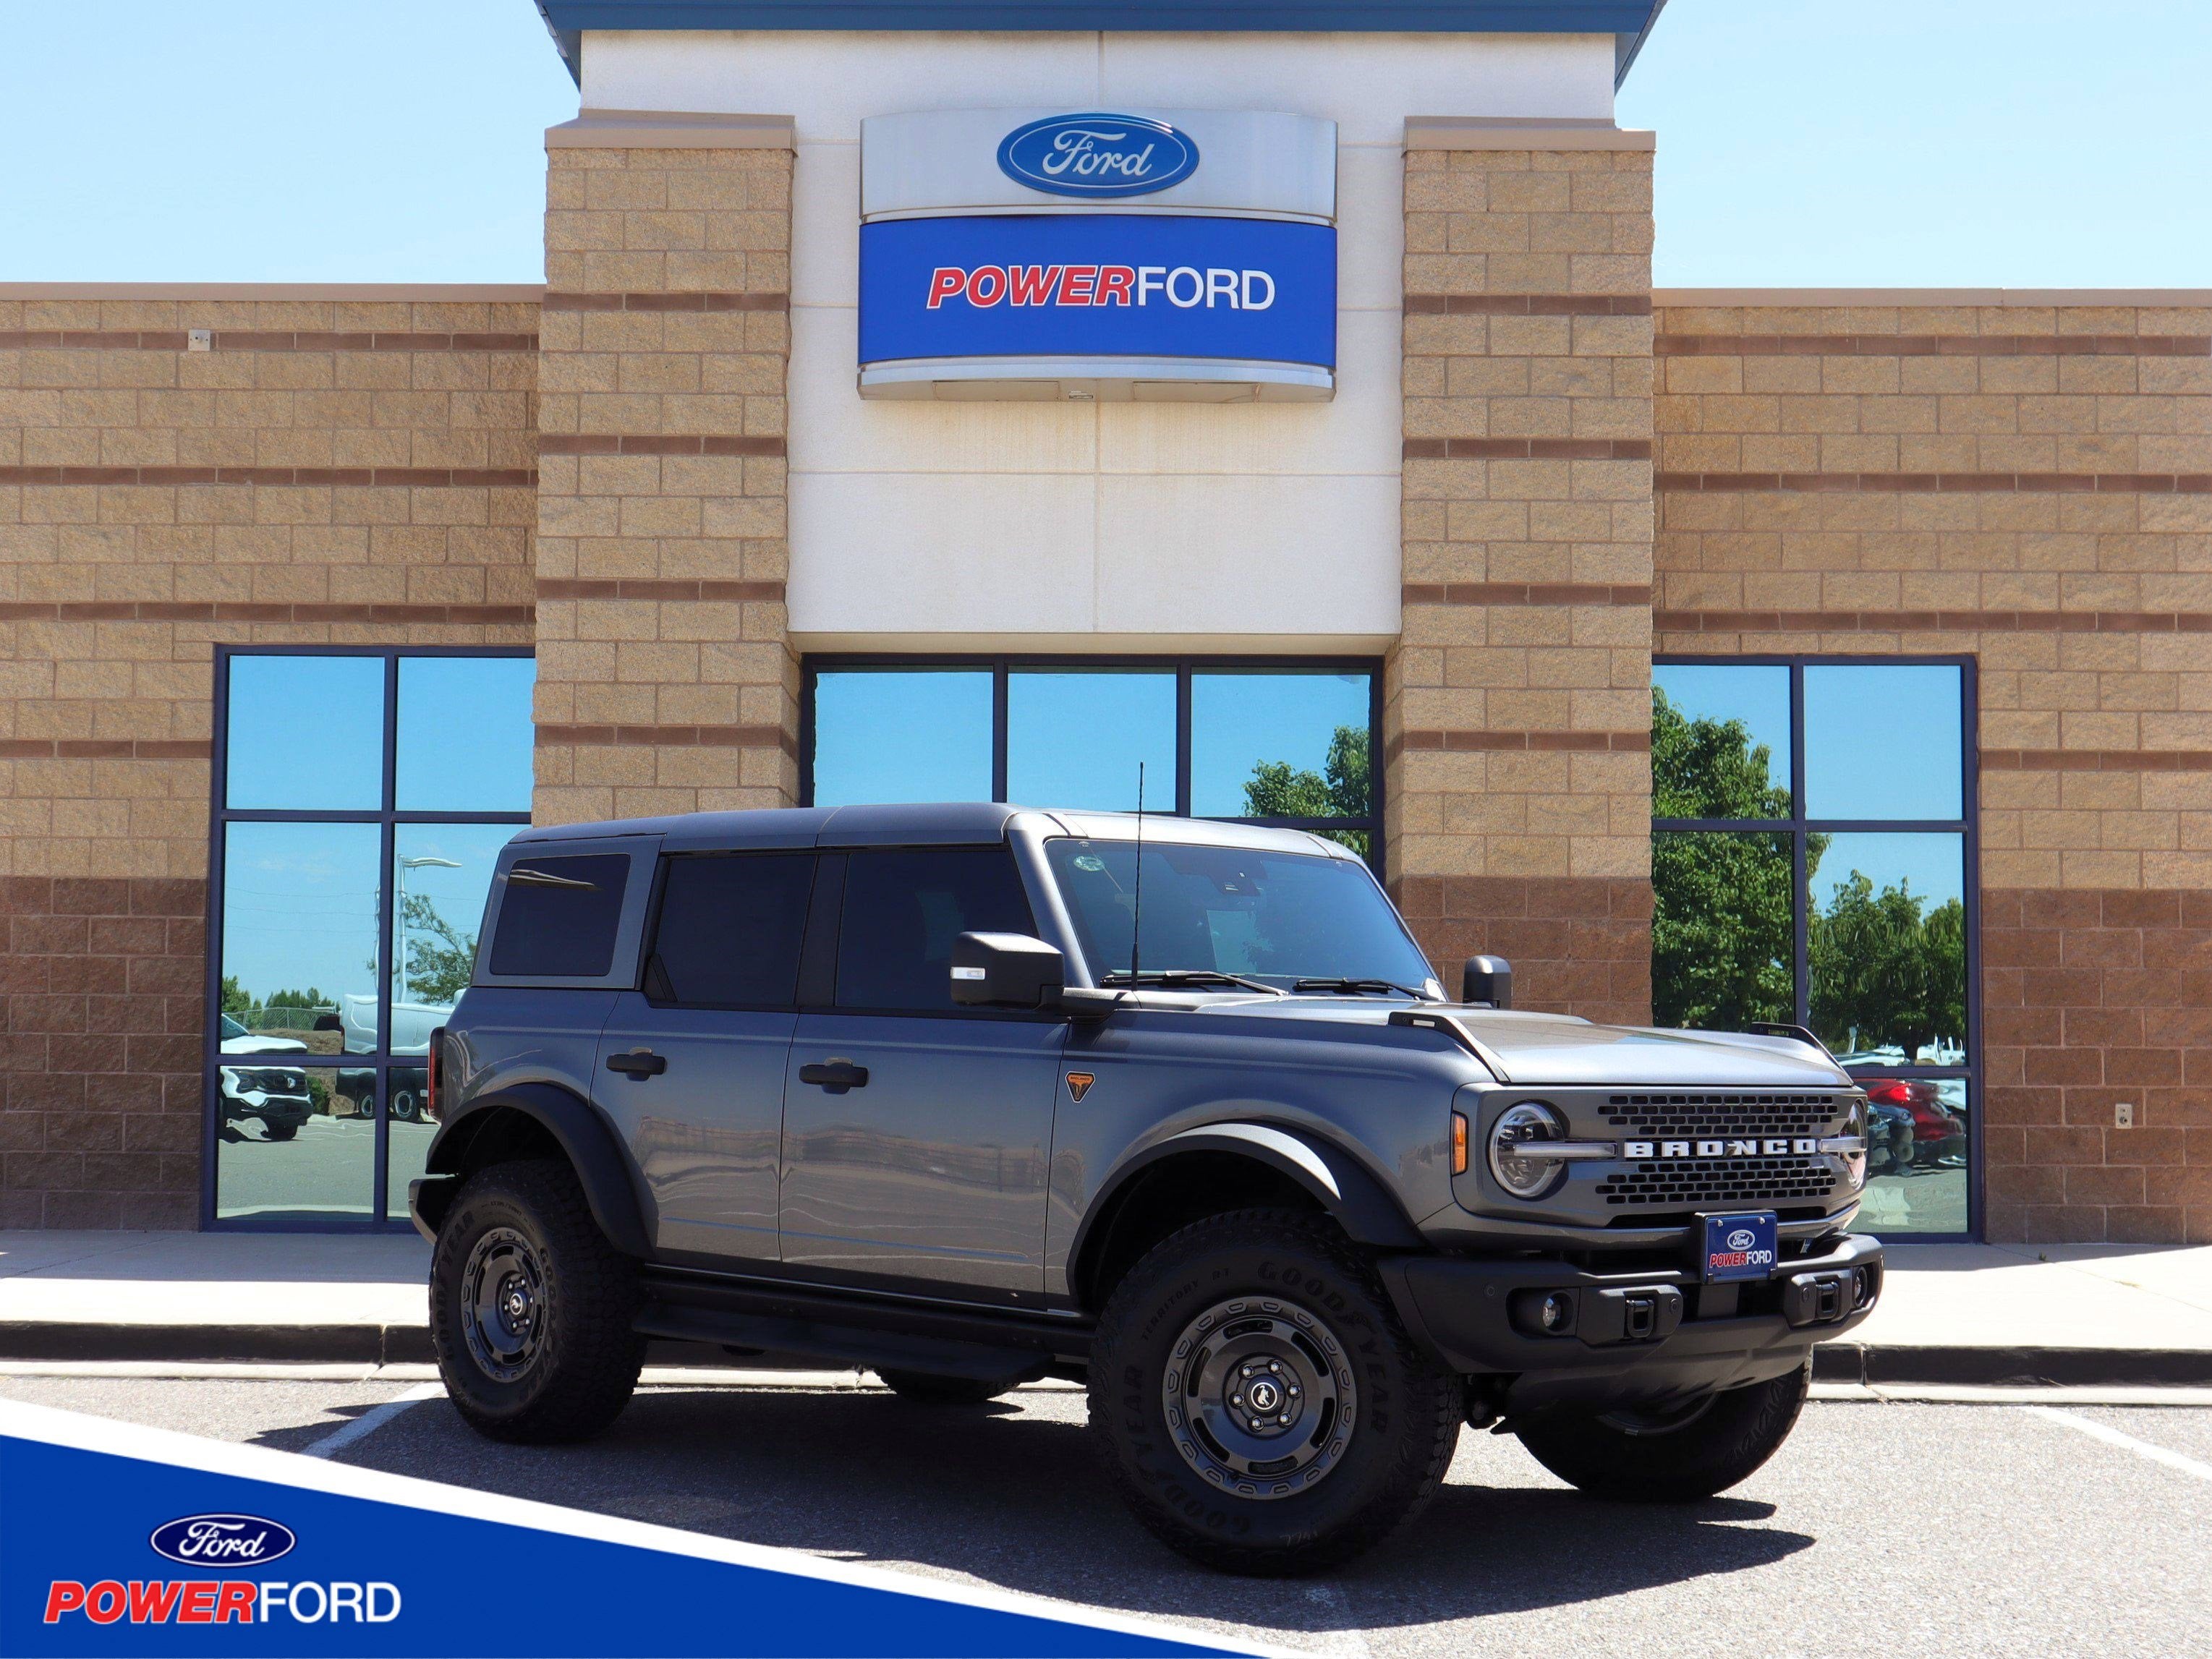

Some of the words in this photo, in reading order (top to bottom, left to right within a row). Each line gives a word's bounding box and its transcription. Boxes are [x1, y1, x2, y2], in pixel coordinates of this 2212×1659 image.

[1042, 129, 1154, 176] Ford
[1625, 1139, 1816, 1159] BRONCO
[1732, 1234, 1749, 1246] Ford
[1141, 1279, 1199, 1341] TERRITORY
[1257, 1261, 1389, 1435] GOODYEAR
